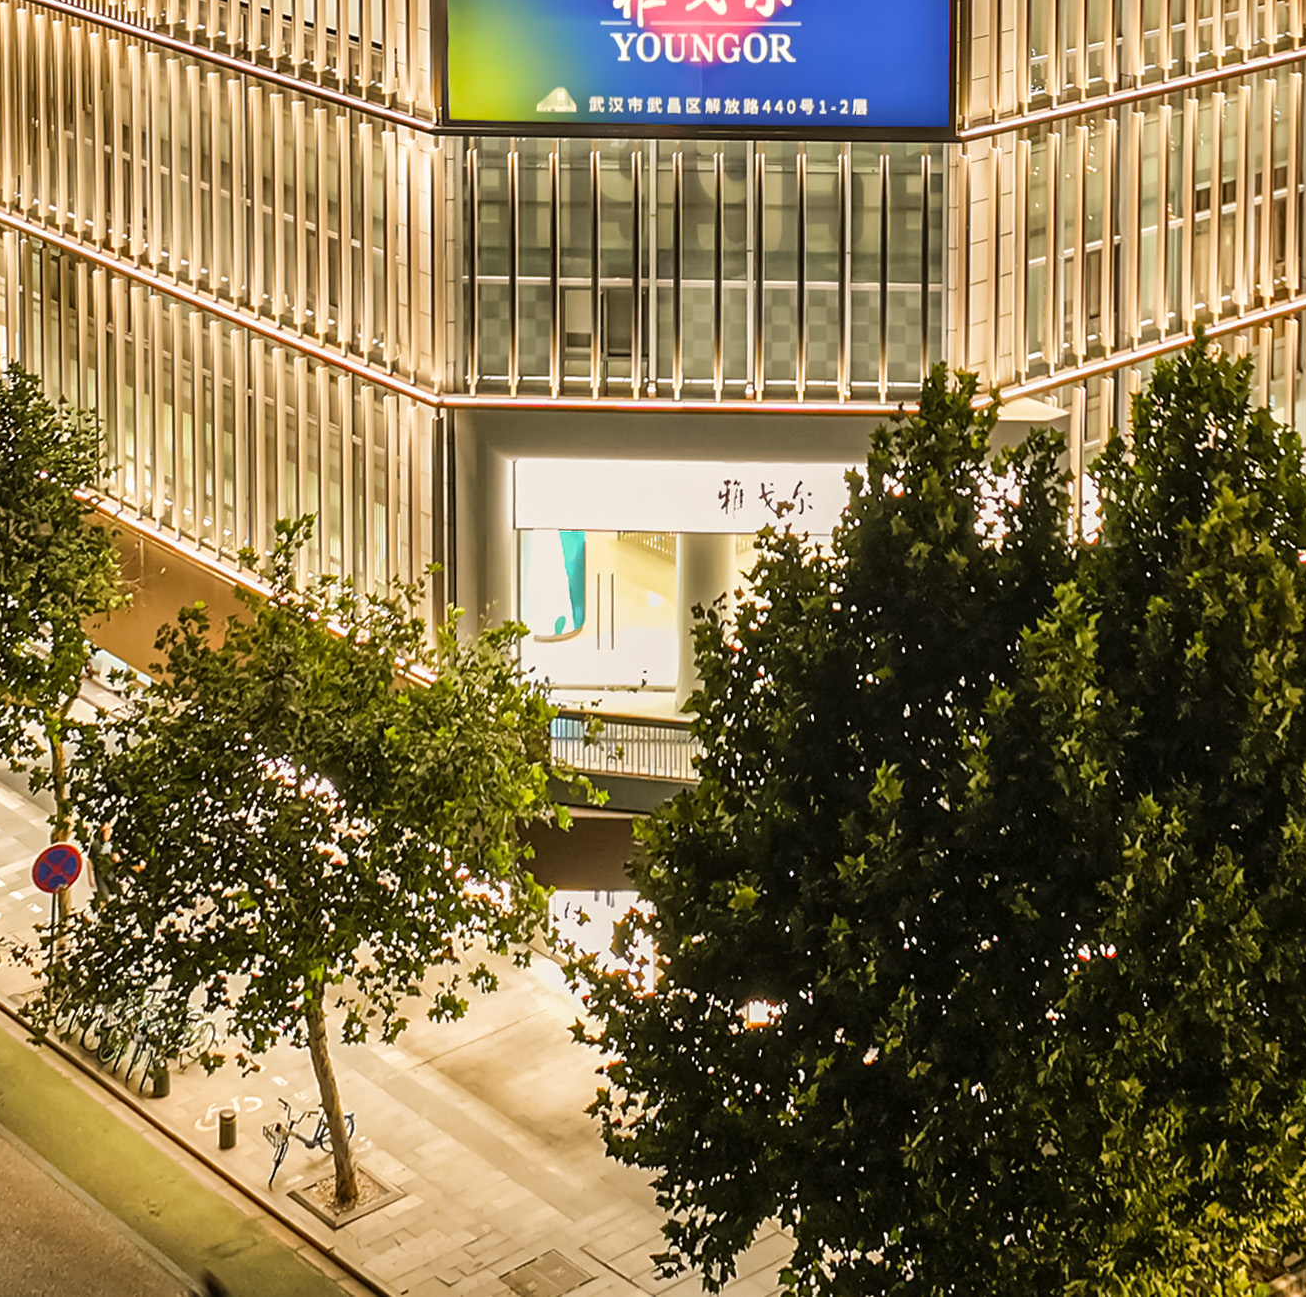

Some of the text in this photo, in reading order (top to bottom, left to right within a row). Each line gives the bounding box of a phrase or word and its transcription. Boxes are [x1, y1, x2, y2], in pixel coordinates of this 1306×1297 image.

[609, 31, 797, 64] YOUNGOR
[588, 95, 869, 116] 武汉市武昌区解放路440号1-2层
